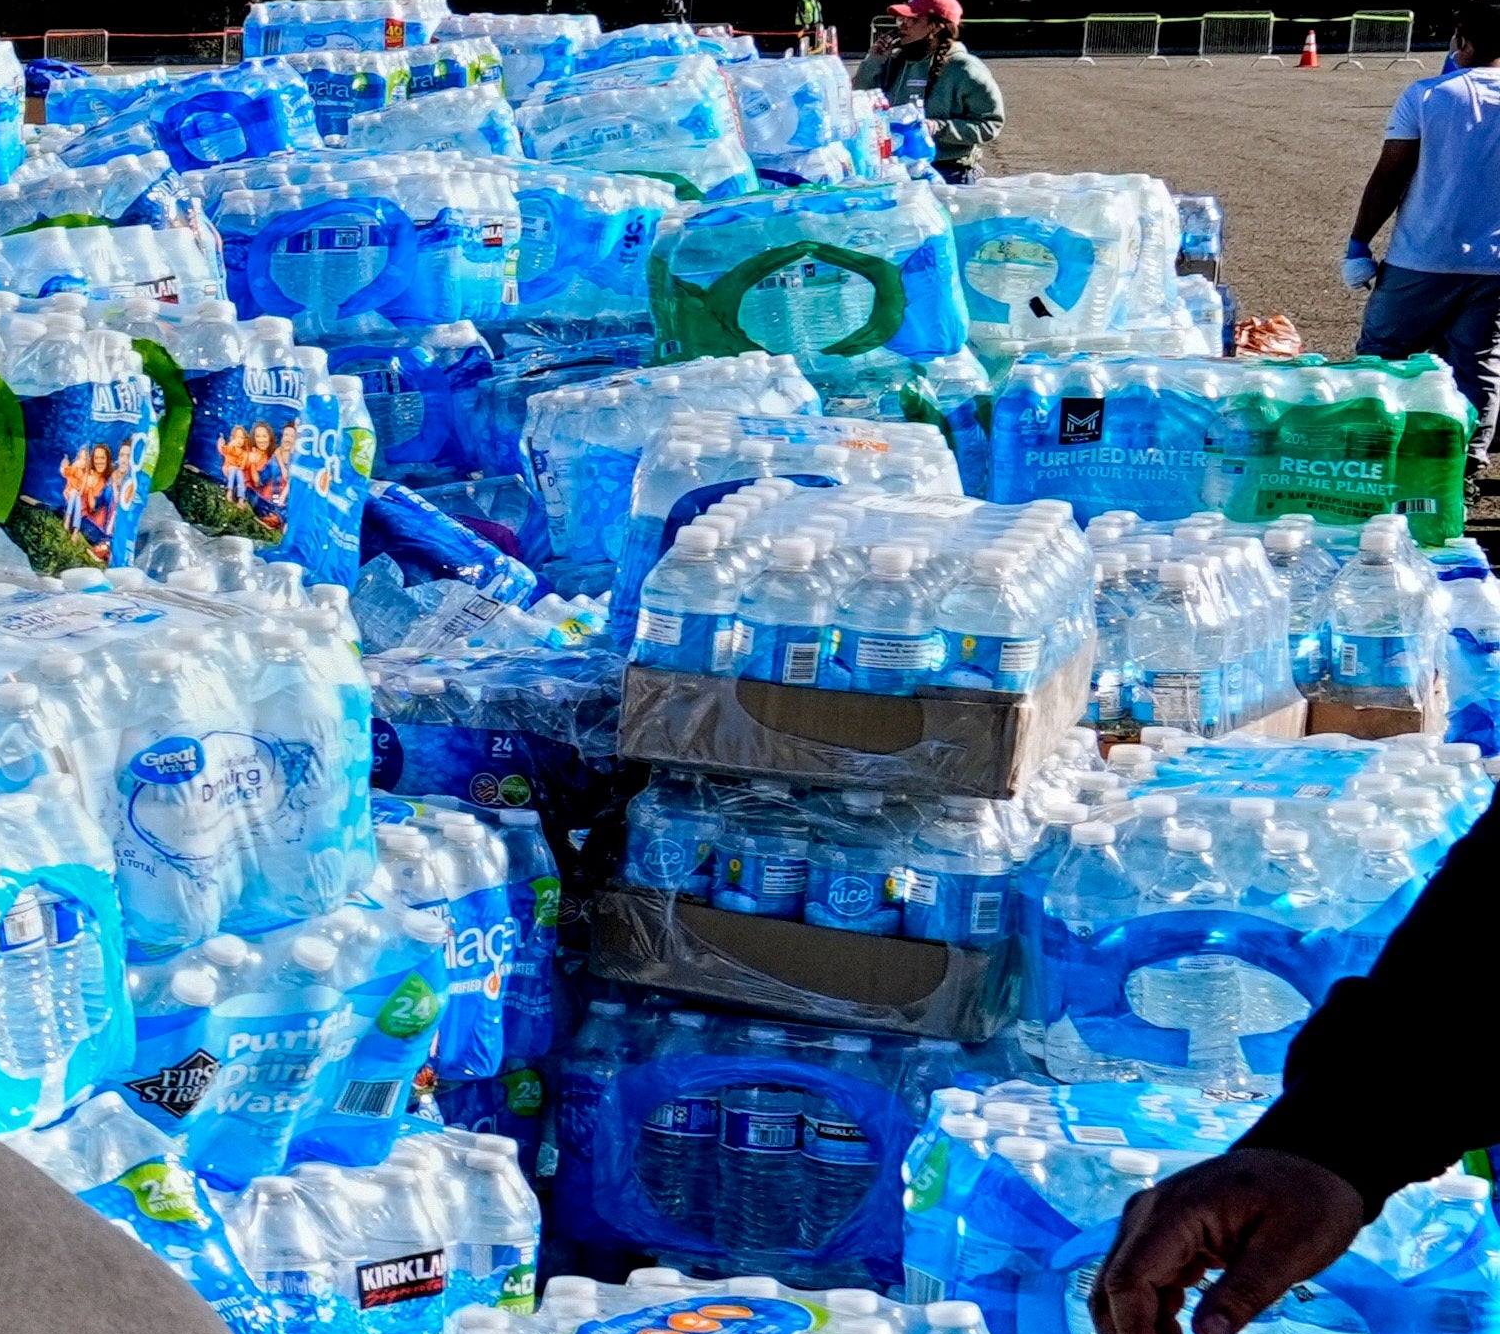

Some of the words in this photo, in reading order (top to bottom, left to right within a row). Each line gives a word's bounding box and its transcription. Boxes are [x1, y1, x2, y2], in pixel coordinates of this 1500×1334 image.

[1025, 448, 1125, 467] PURIFIED
[1126, 449, 1208, 467] WATER
[1279, 456, 1383, 480] RECYCLE
[1036, 467, 1069, 480] FOR
[1073, 467, 1122, 479] YOUR
[1126, 468, 1191, 481] THIRST
[1259, 473, 1292, 485] FOR
[1296, 476, 1332, 489] THE
[1336, 480, 1399, 497] PLANET
[491, 737, 513, 752] 24
[139, 746, 197, 767] Great
[395, 998, 431, 1019] 24
[517, 1083, 541, 1099] 24
[504, 1274, 535, 1297] 40
